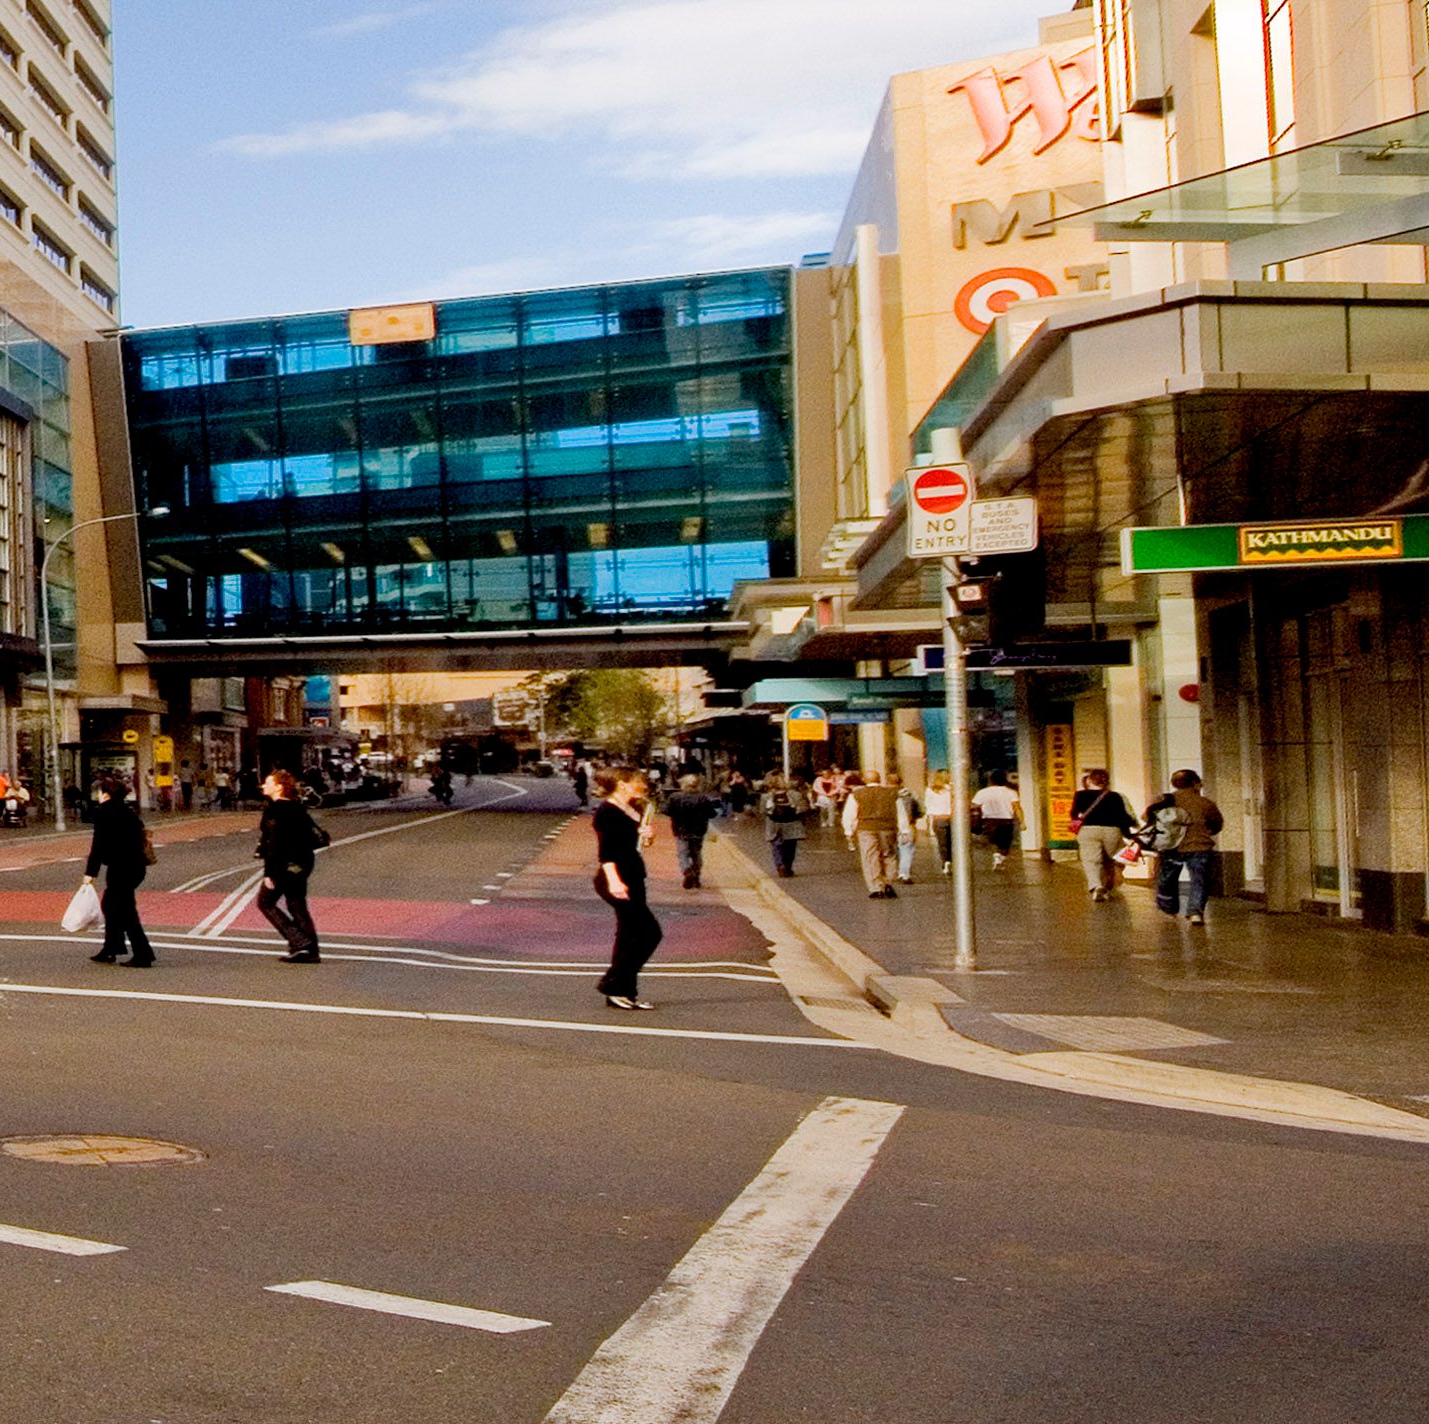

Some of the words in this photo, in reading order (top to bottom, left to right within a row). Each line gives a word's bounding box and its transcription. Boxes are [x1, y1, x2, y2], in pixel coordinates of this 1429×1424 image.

[926, 518, 957, 533] NO
[915, 535, 967, 550] ENTRY
[1247, 526, 1393, 548] KATHMANDU
